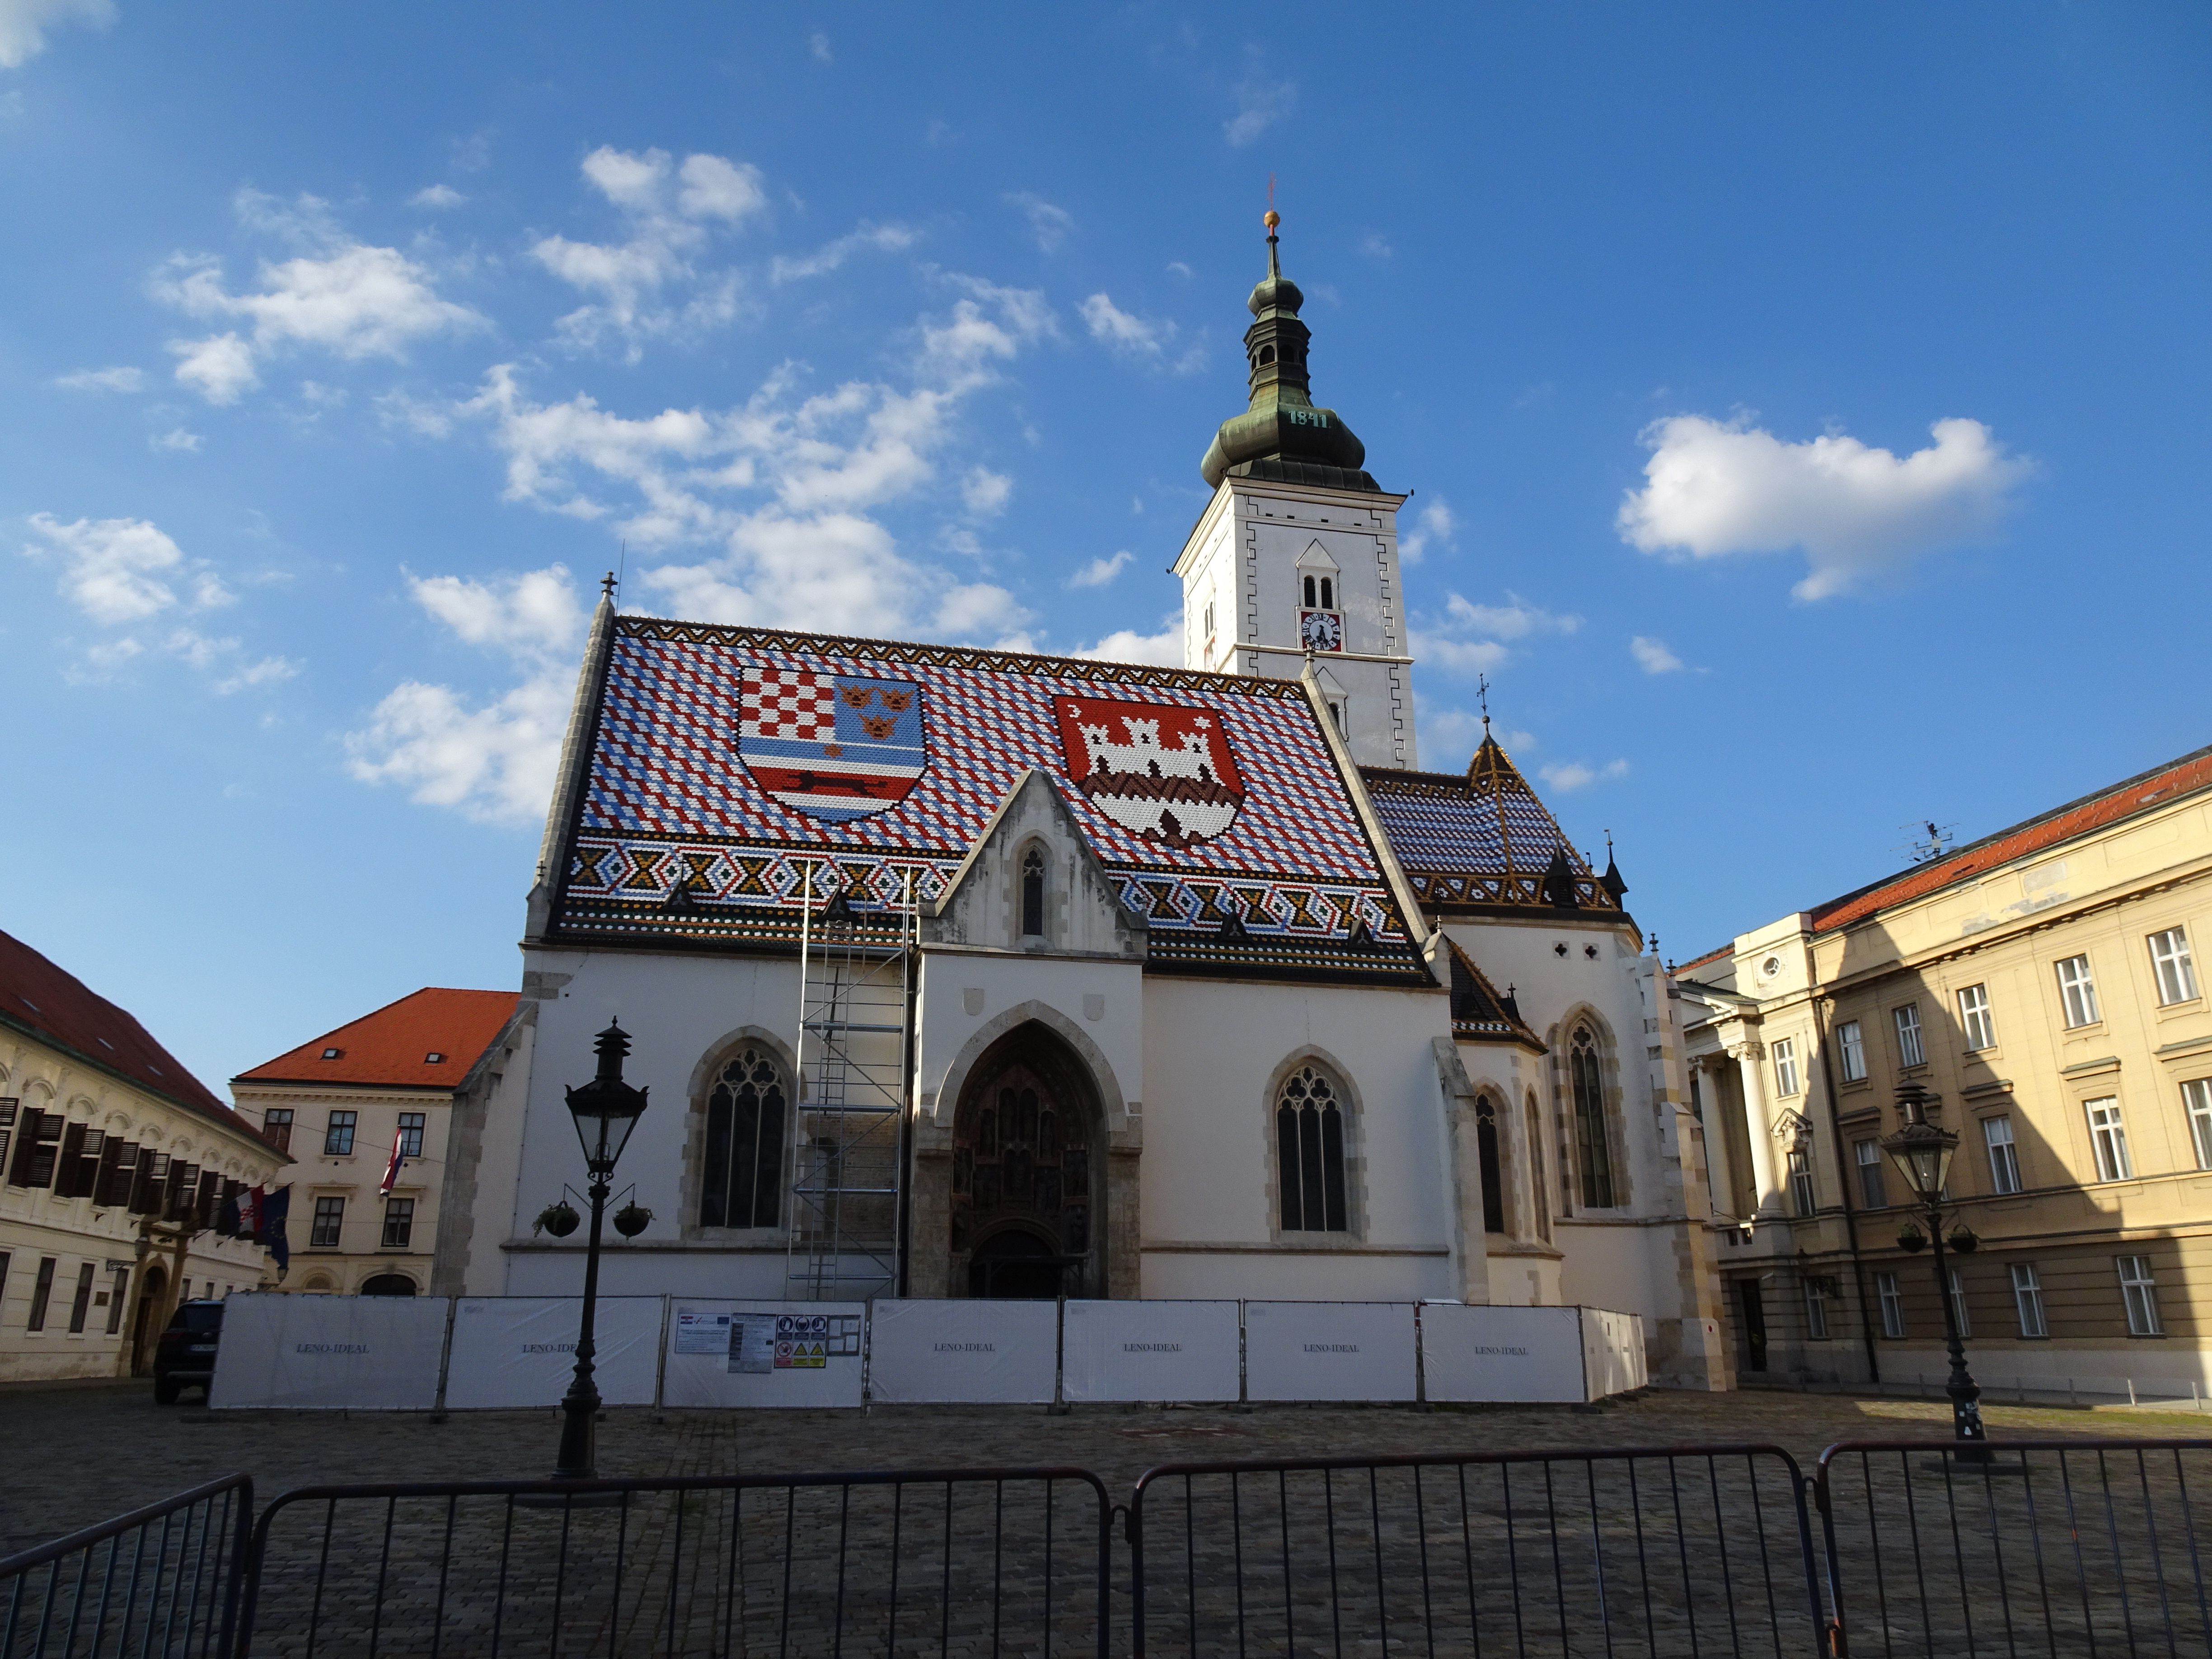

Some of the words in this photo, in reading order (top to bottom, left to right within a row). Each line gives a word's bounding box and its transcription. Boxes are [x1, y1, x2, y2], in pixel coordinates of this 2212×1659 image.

[1288, 410, 1327, 428] 1841
[296, 1343, 370, 1354] LENO-IDEAL
[523, 1344, 577, 1353] LENO-IDE
[934, 1343, 995, 1352] LENO-IDEAL
[1124, 1344, 1182, 1352] LENO-IDEAL
[1303, 1344, 1359, 1353] LENO-IDEAL
[1475, 1346, 1529, 1355] LENO-IDEAL
